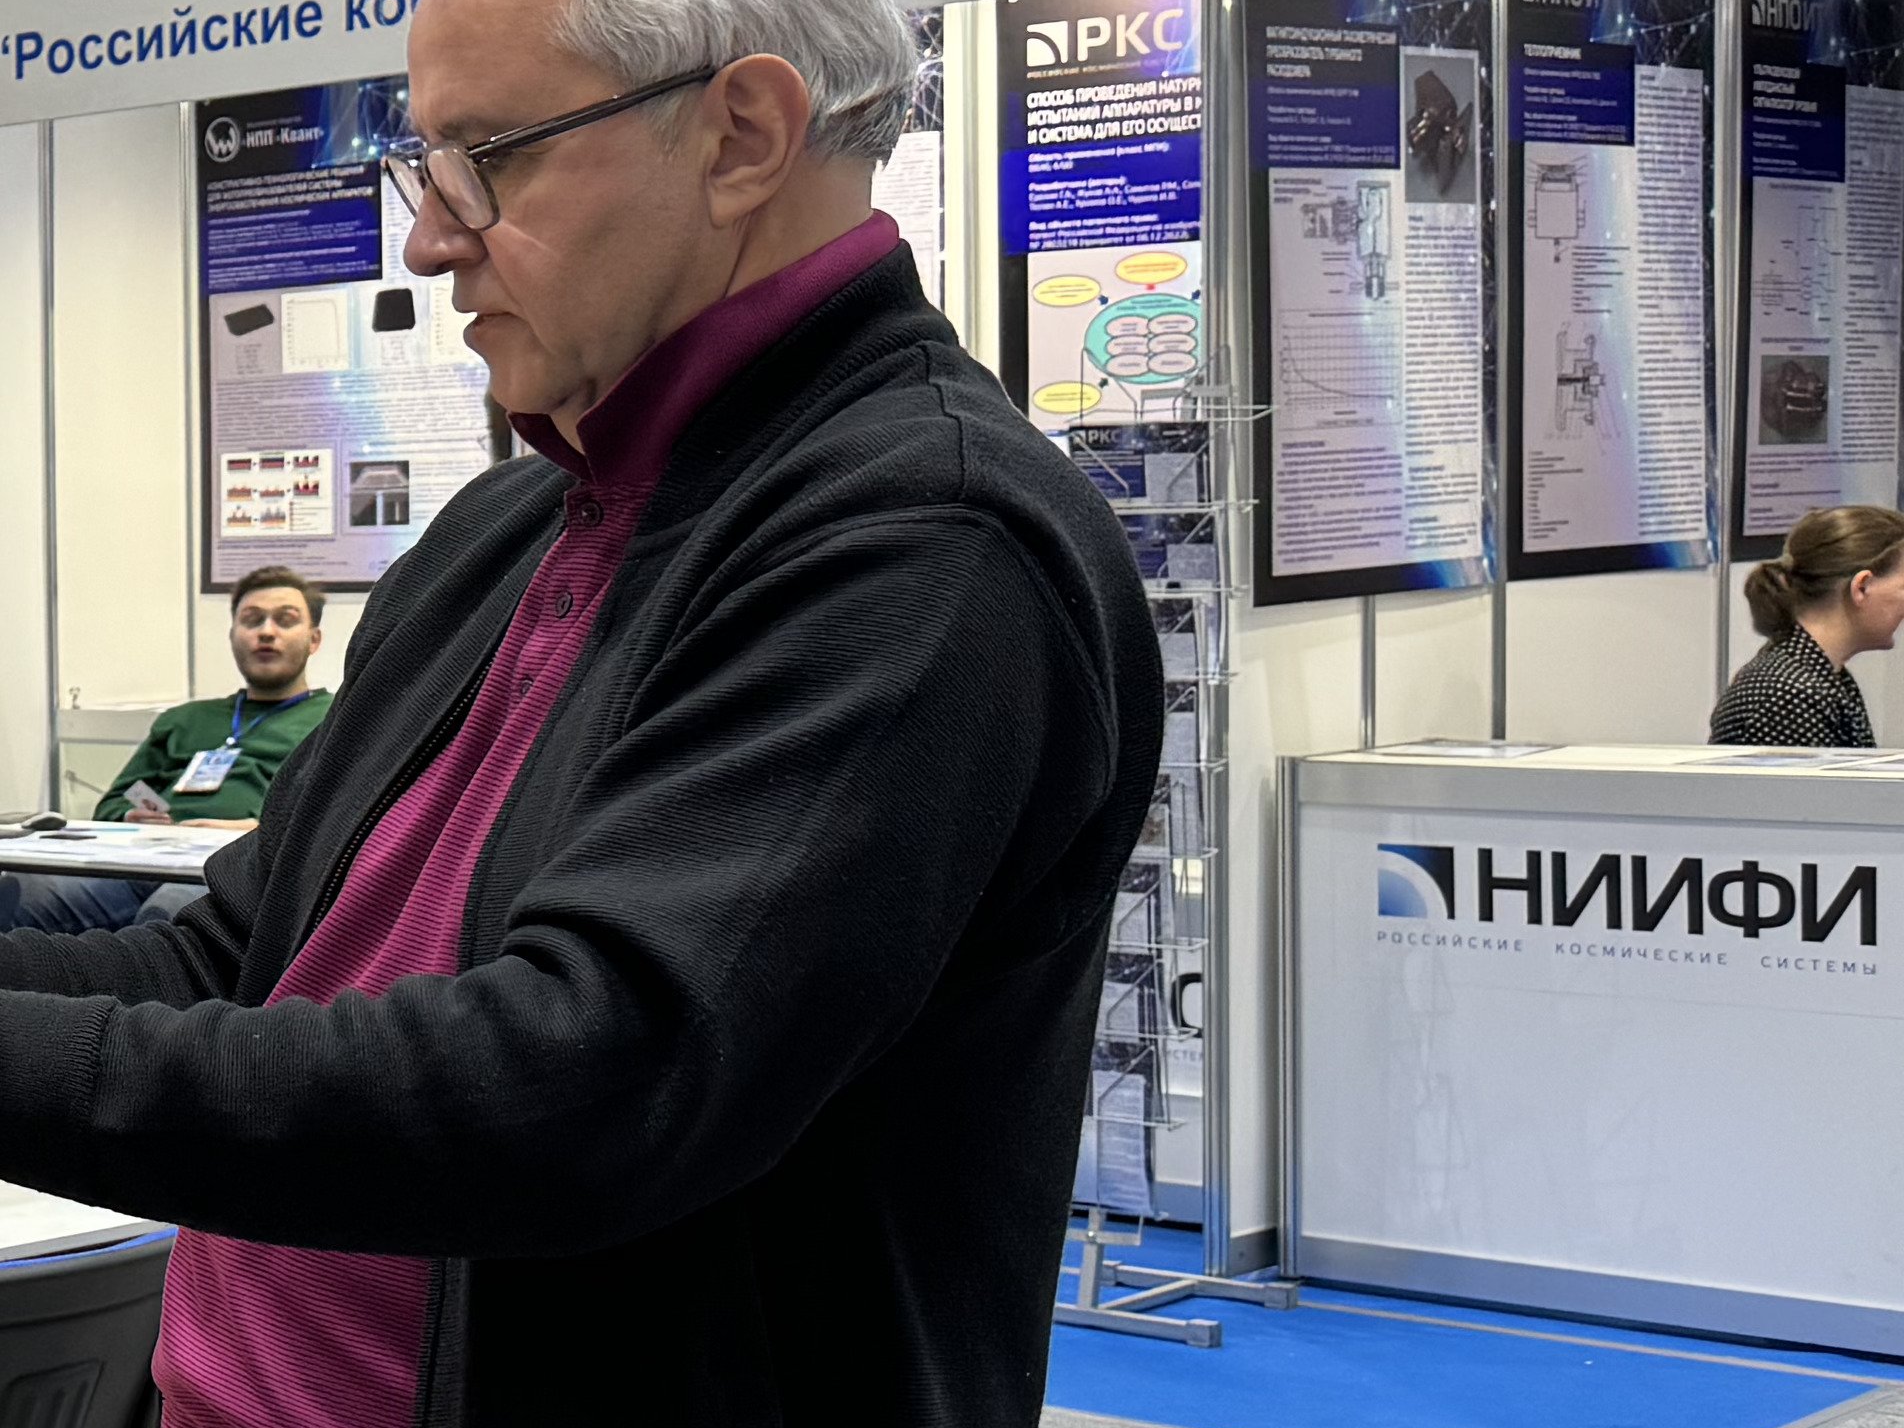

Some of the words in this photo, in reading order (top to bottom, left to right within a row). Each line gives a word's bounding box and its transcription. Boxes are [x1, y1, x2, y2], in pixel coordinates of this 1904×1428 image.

[1077, 8, 1183, 61] РКС
[1478, 846, 1878, 948] НИИФИ
[1377, 930, 1525, 953] РОССИЙСКИЕ
[1555, 942, 1728, 966] КОСМИЧЕСКИЕ
[1760, 954, 1878, 976] СИСТЕМЫ
